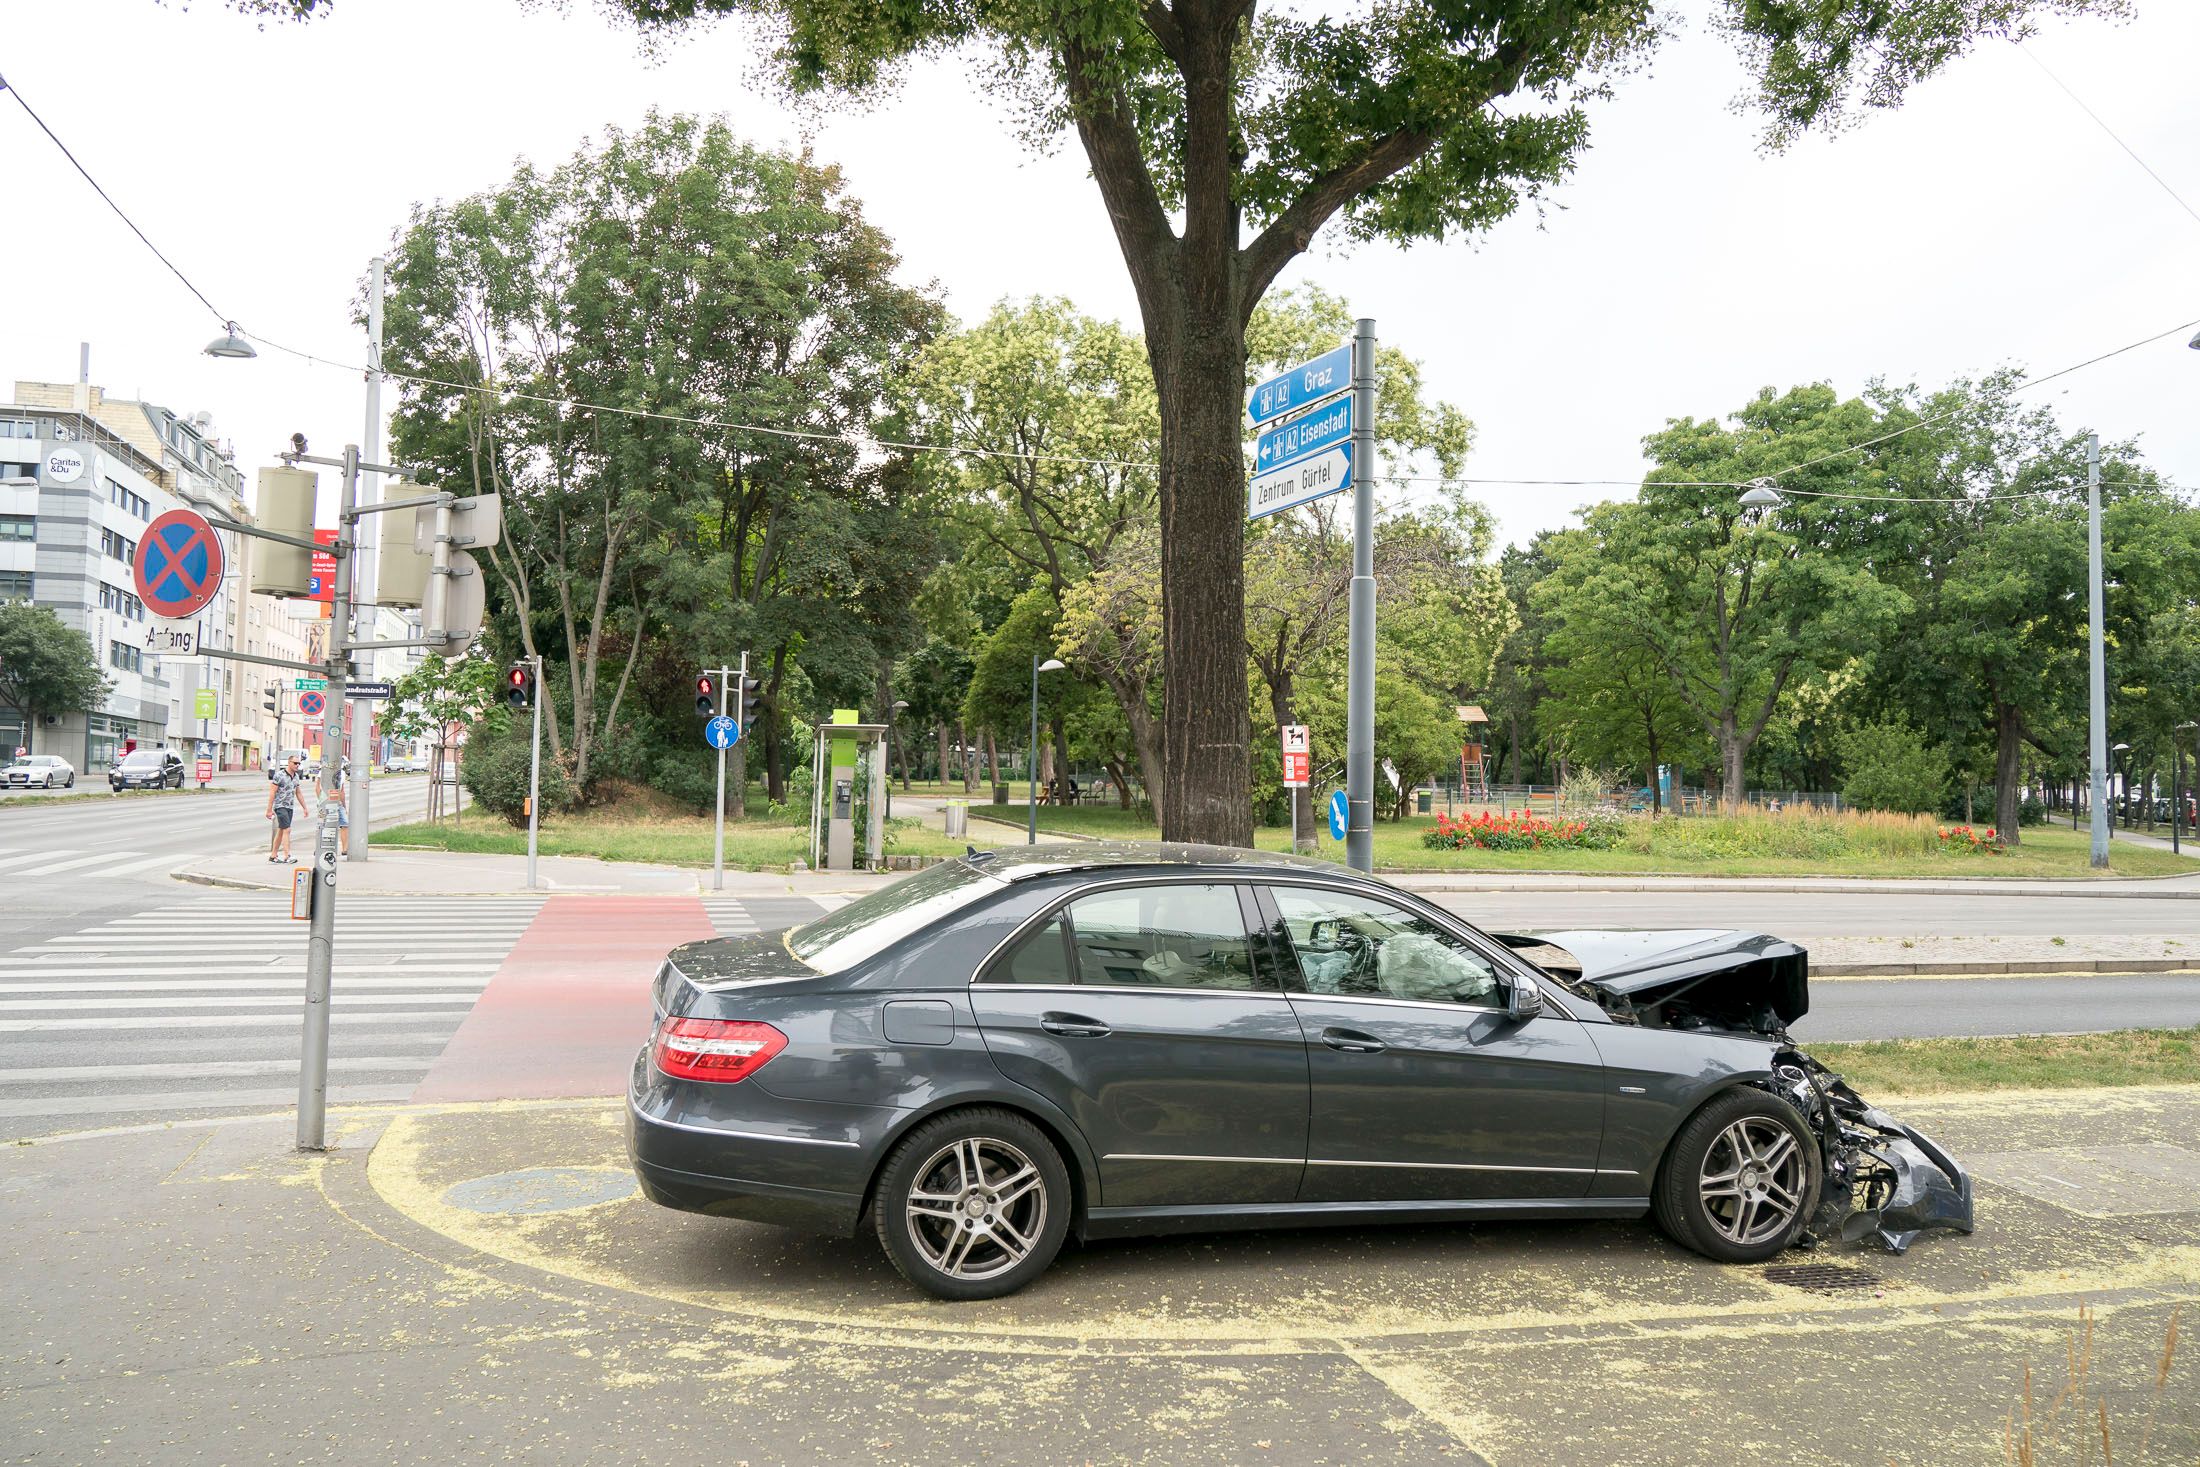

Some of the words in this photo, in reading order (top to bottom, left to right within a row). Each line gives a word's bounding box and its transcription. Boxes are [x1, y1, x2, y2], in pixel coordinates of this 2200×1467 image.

[1278, 384, 1288, 404] A2
[1304, 367, 1333, 393] Graz
[1287, 429, 1297, 453] A2
[1300, 405, 1347, 446] Eisenstadt
[50, 457, 81, 467] Caritas
[50, 465, 69, 473] &Du
[1258, 479, 1294, 505] Zentrum
[1302, 461, 1331, 490] Gürtel
